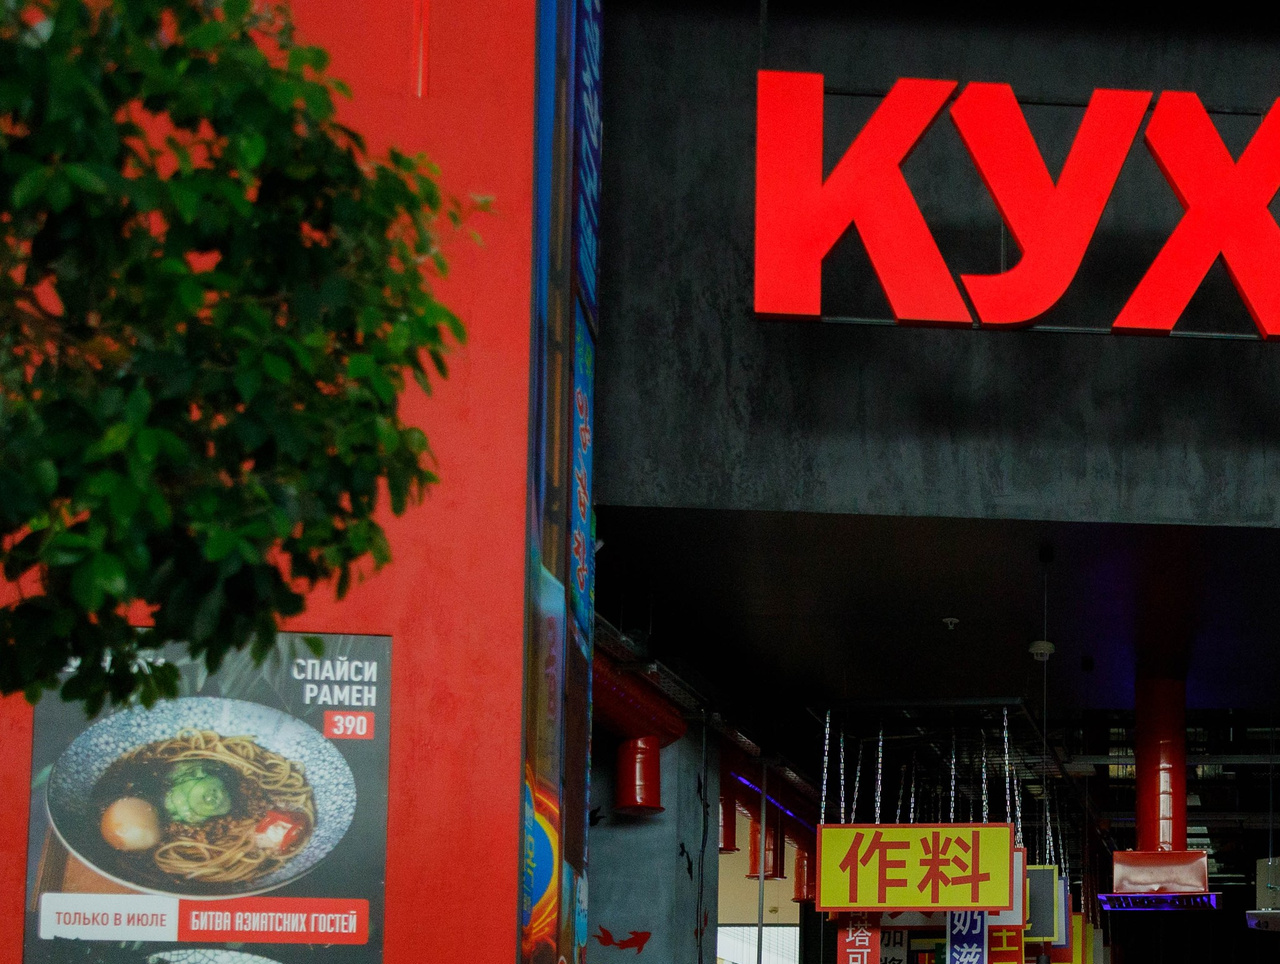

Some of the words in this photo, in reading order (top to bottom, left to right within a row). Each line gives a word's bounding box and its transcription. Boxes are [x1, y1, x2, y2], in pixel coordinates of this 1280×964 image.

[294, 656, 377, 682] СПАЙСИ
[304, 683, 377, 706] РАМЕН
[332, 715, 368, 736] 390
[838, 830, 991, 905] 作料
[55, 911, 110, 927] ТОЛЬКО
[114, 913, 123, 926] В
[126, 912, 168, 927] ИЮЛЕ
[190, 911, 231, 931] БИТВА
